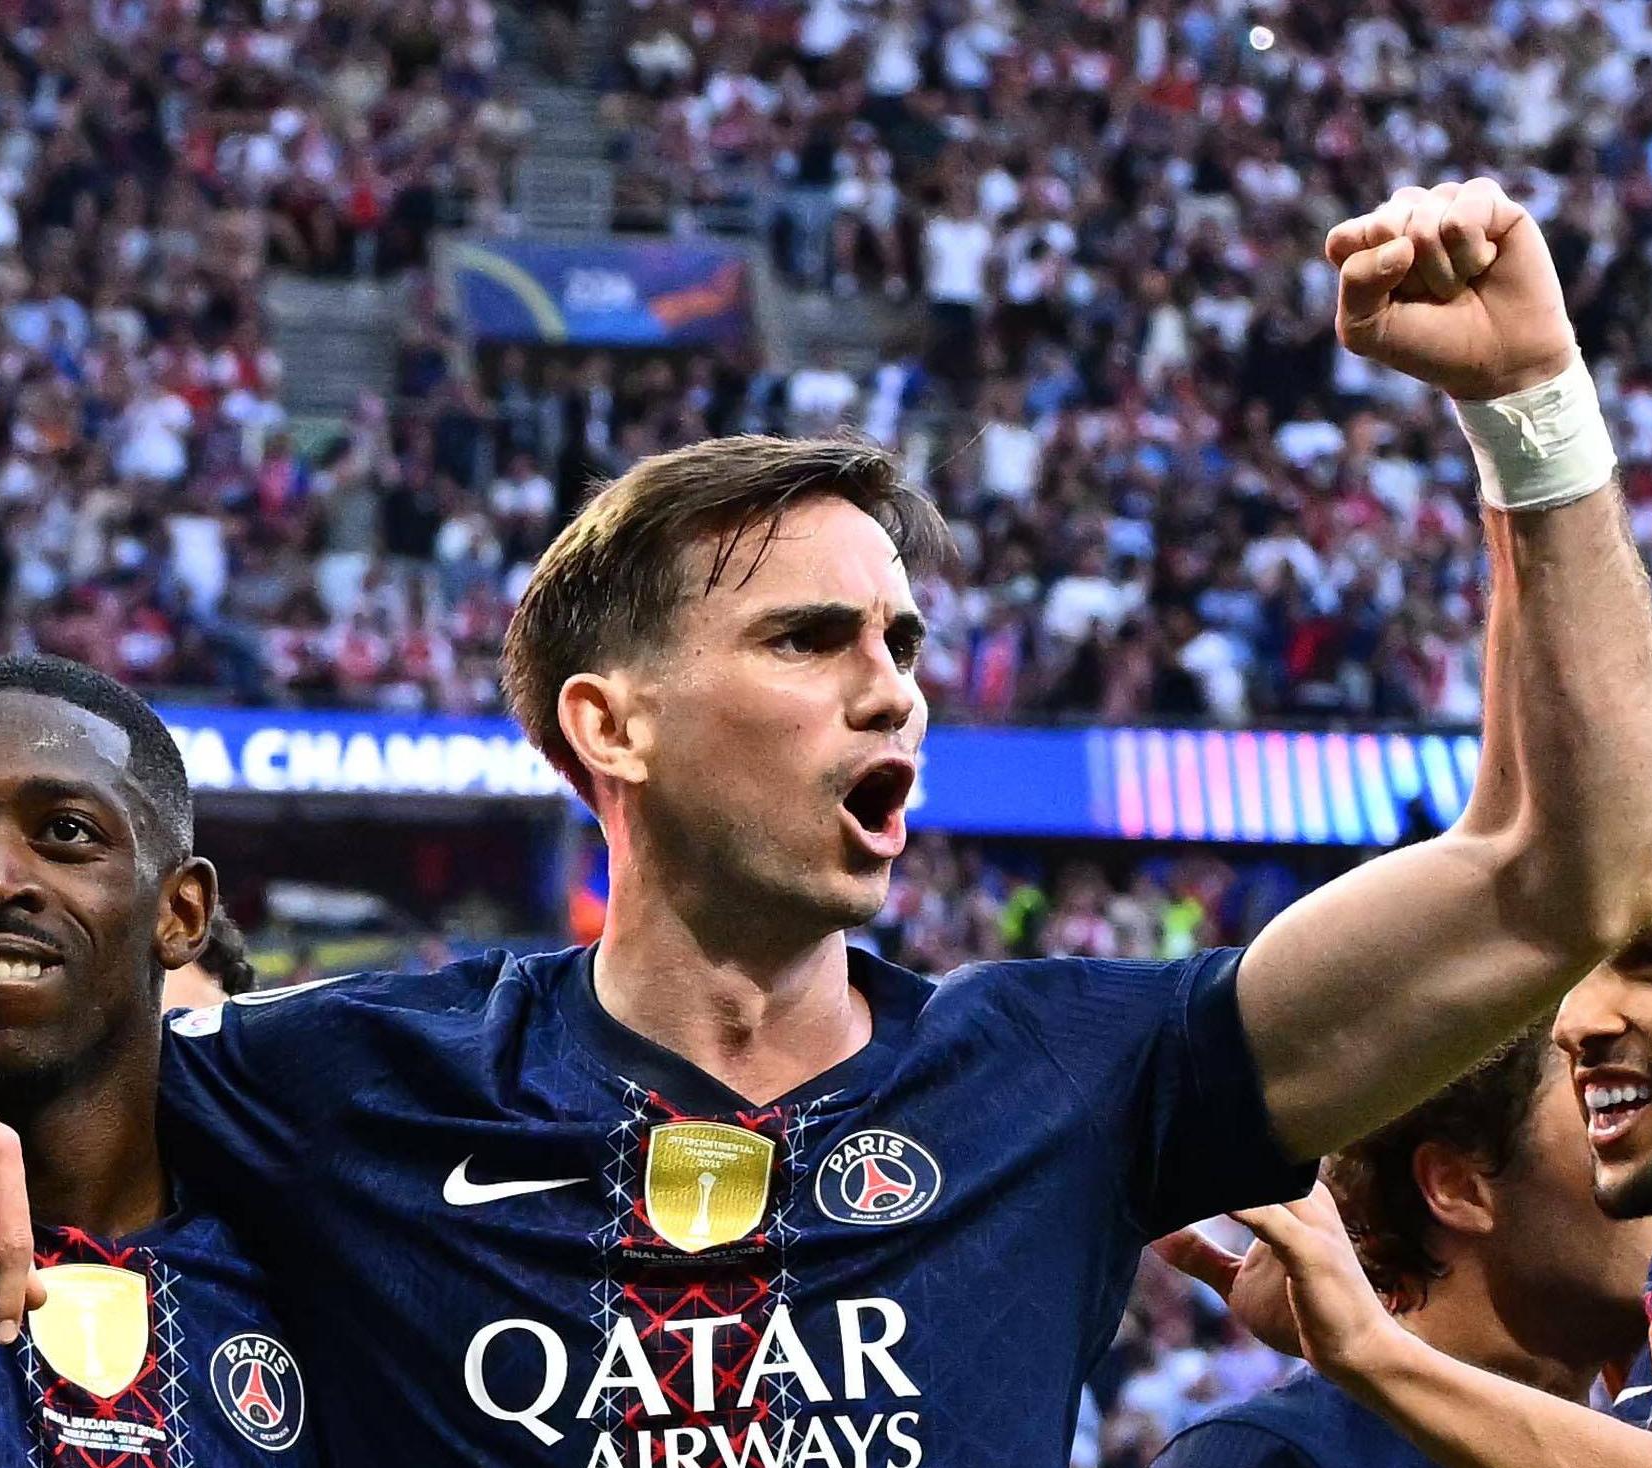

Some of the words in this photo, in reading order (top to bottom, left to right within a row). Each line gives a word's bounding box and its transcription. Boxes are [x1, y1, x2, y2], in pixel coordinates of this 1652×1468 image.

[240, 727, 578, 793] CHAMPIO
[828, 1135, 904, 1173] PARIS
[224, 1340, 289, 1374] PARIS
[464, 1297, 922, 1446] QATAR
